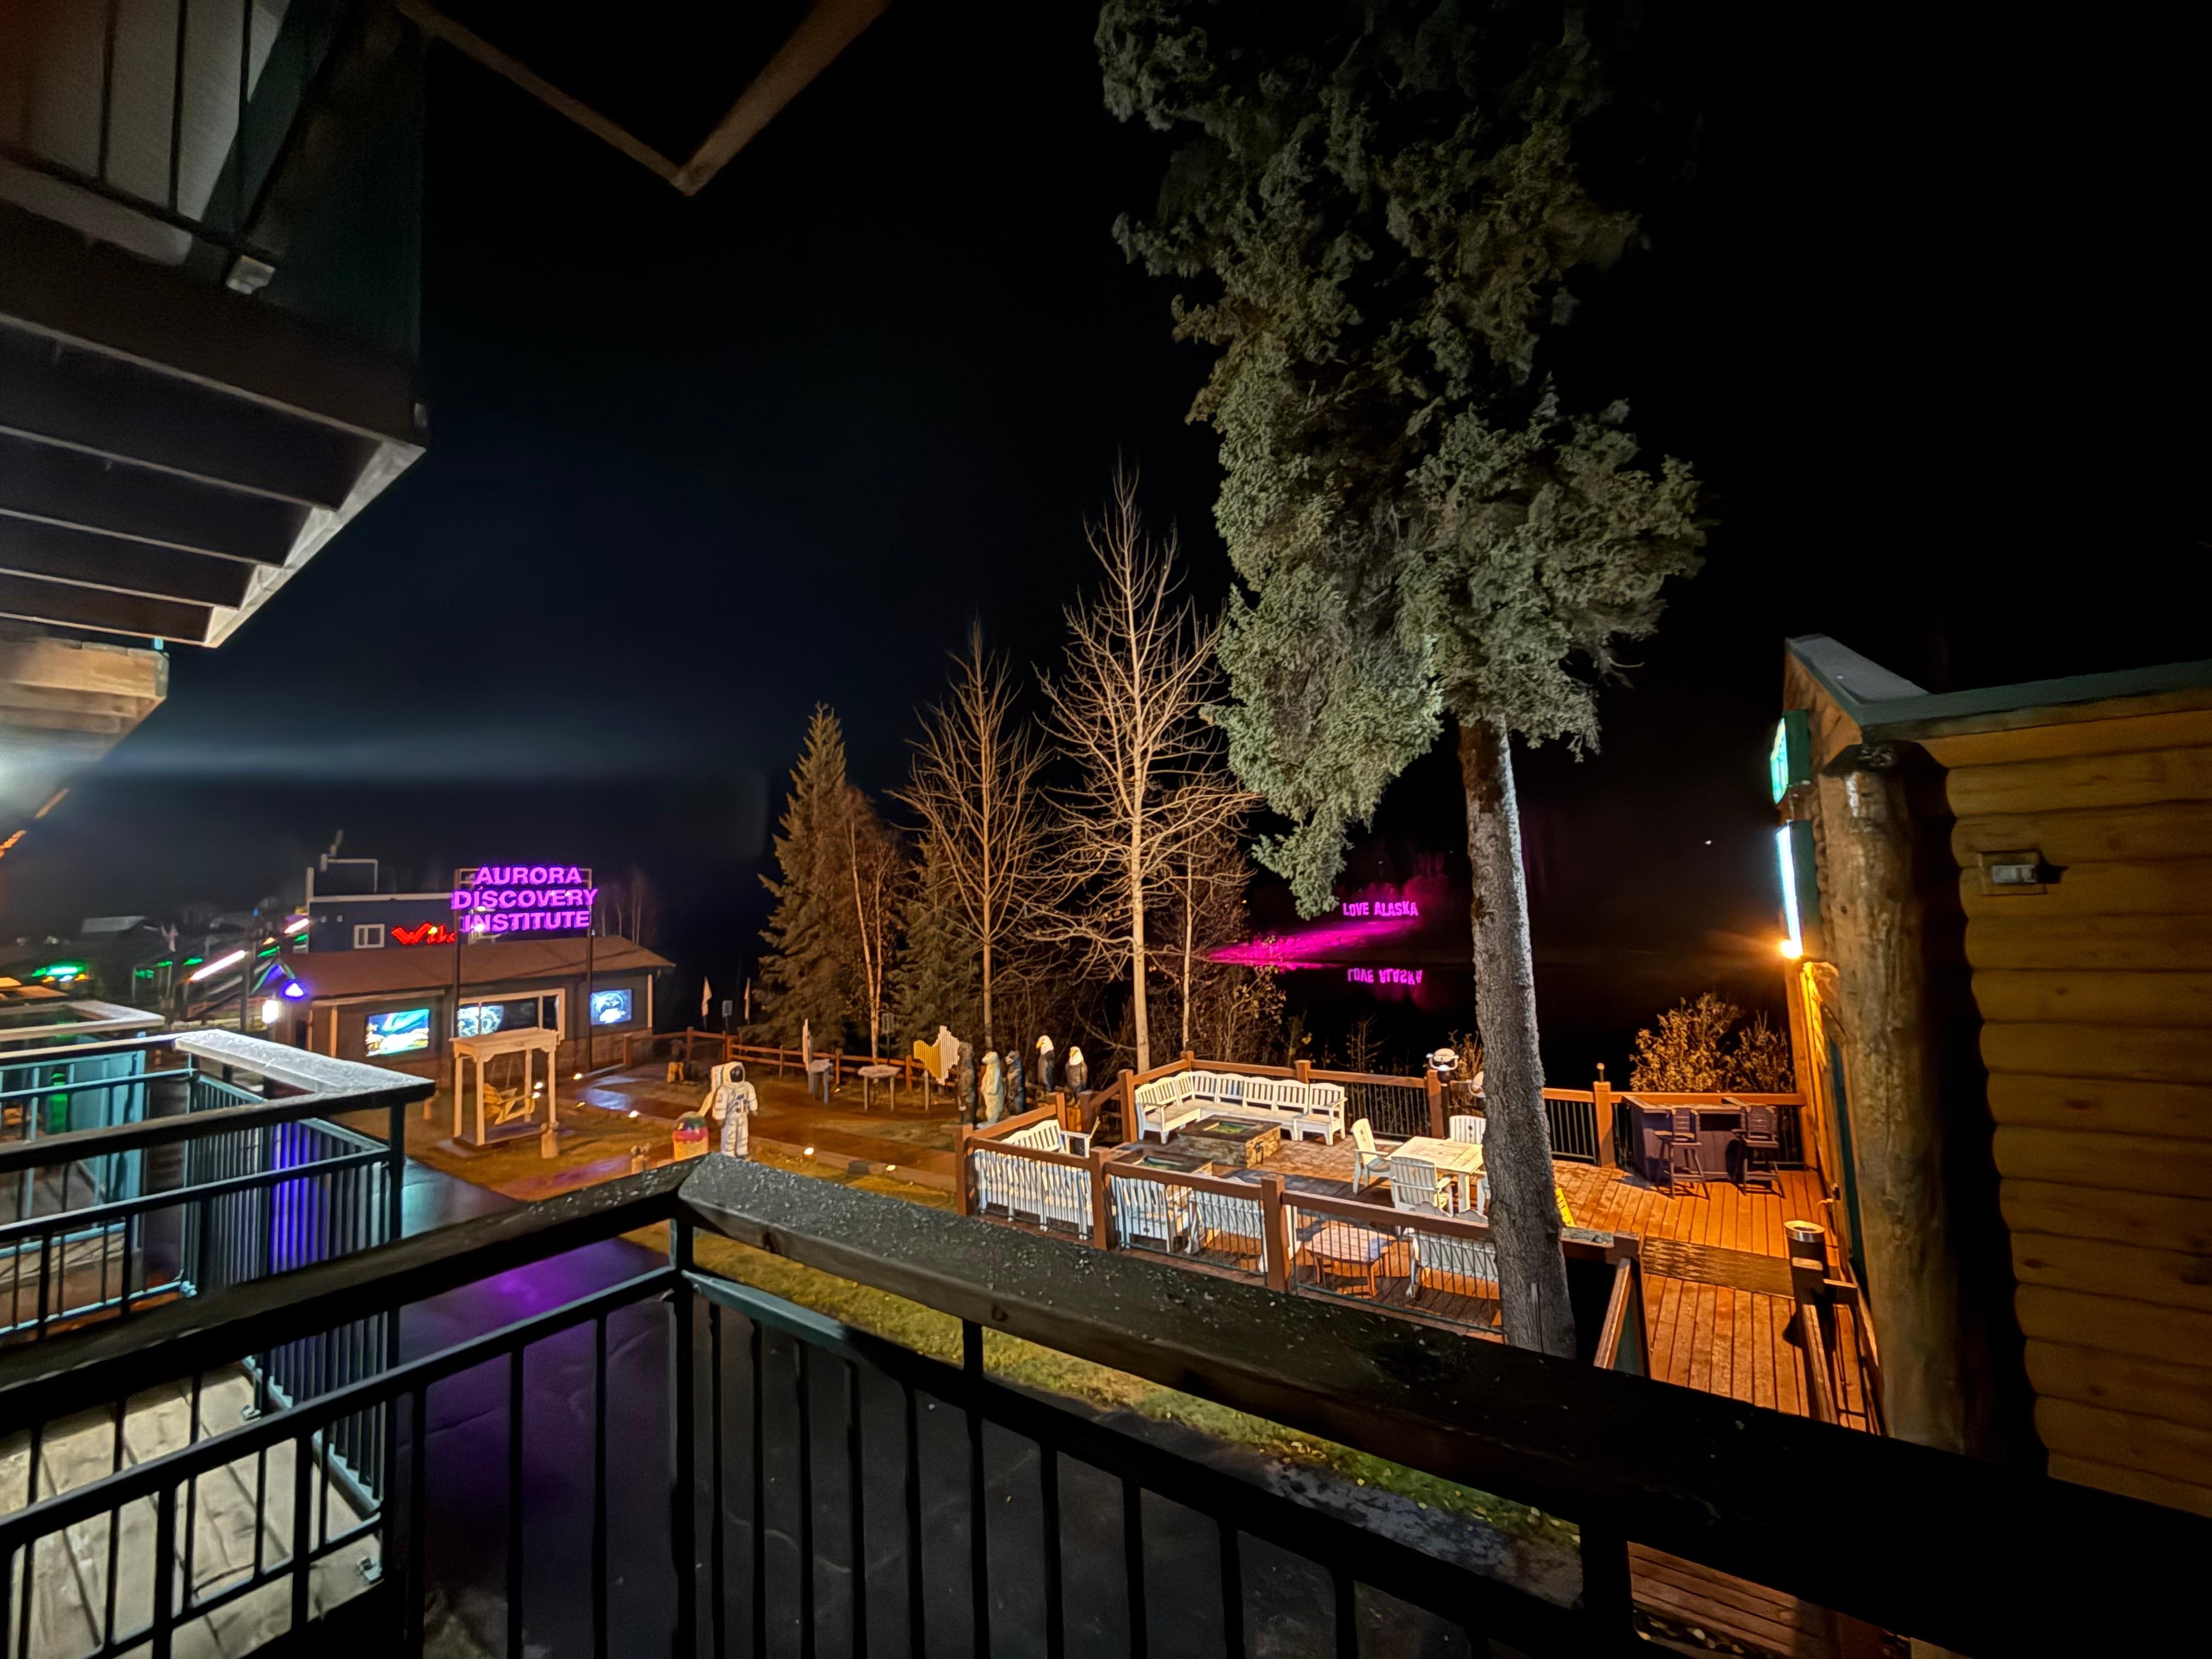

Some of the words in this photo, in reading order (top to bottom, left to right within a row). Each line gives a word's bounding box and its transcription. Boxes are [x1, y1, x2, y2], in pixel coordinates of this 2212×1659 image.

[473, 866, 583, 885] AURORA
[451, 888, 598, 910] DISCOVERY
[1343, 902, 1369, 916] LOVE
[1374, 901, 1418, 916] ALASKA
[460, 911, 590, 933] INSTITUTE
